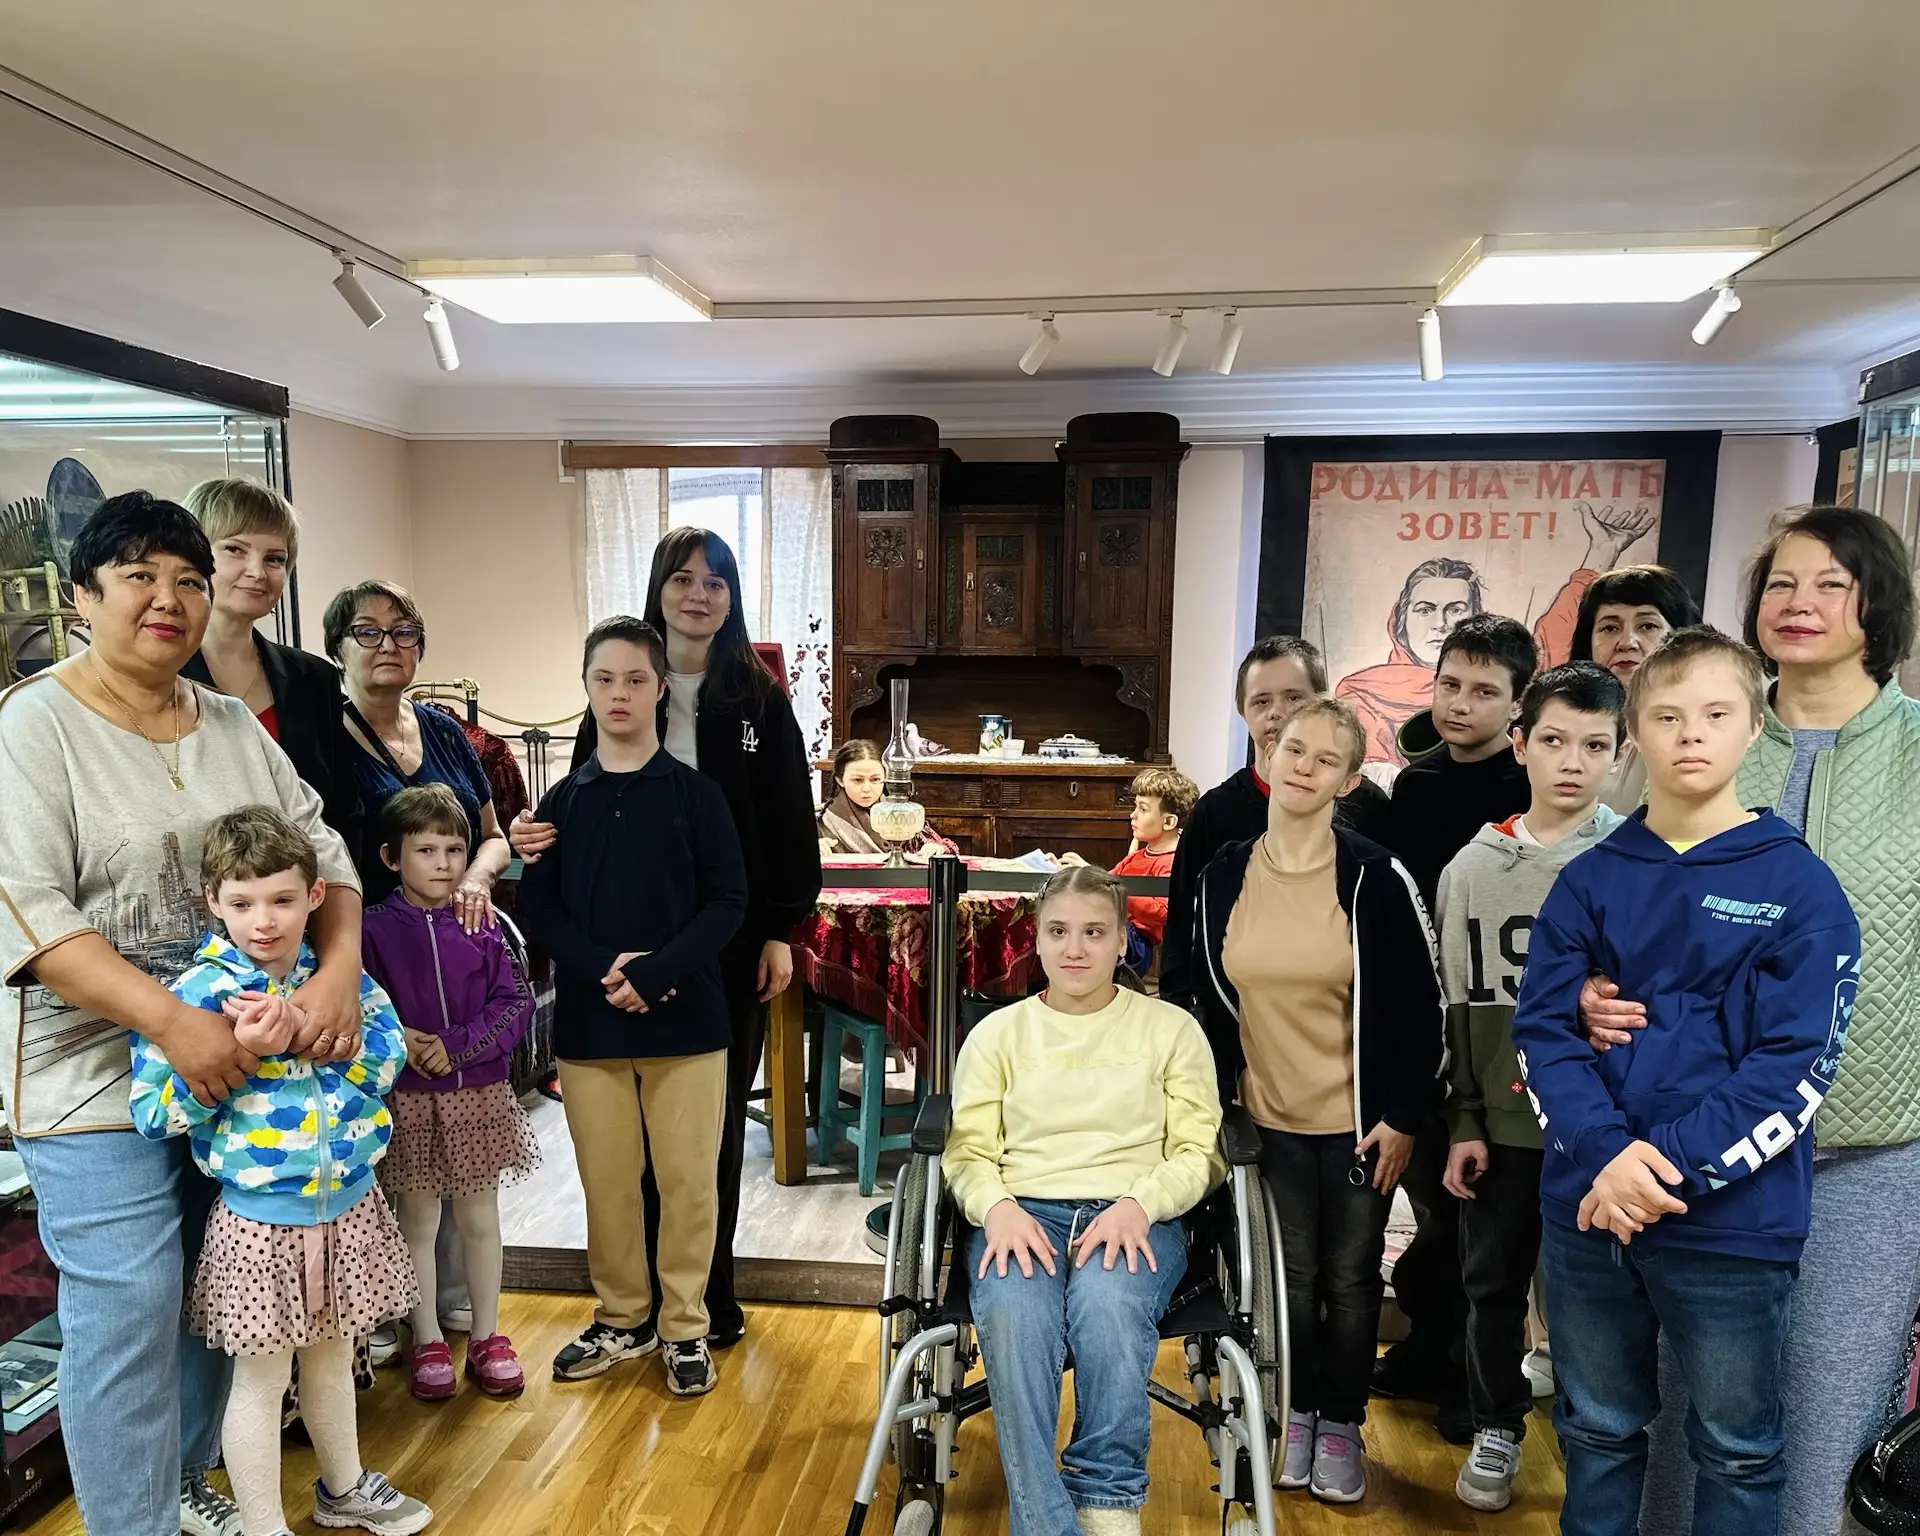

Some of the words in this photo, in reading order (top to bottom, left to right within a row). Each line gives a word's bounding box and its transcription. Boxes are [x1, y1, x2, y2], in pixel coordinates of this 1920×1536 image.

[1311, 462, 1660, 503] РОДИНА-МАТЬ
[1397, 511, 1557, 541] ЗОВЕТ!
[741, 720, 759, 752] LA
[1467, 915, 1535, 1002] 19
